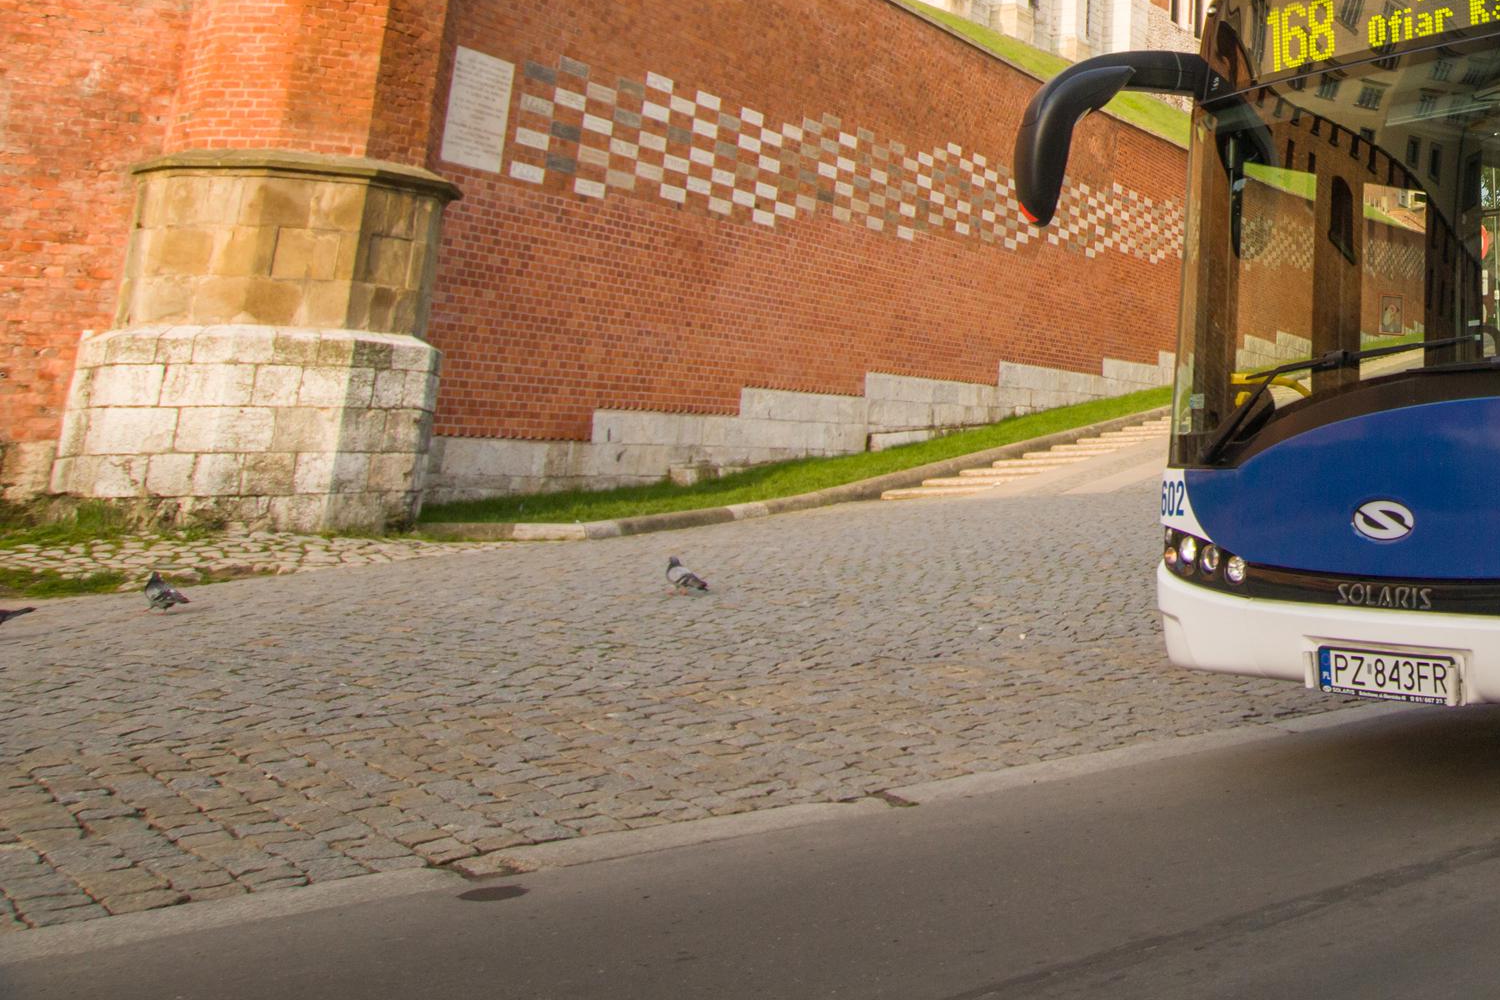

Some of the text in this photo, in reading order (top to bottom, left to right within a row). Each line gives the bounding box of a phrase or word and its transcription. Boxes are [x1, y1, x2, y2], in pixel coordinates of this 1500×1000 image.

[1368, 7, 1453, 47] Ofiar
[1161, 480, 1185, 517] 602
[1336, 583, 1433, 610] SOLARIS
[1334, 653, 1448, 694] PZ 843FR
